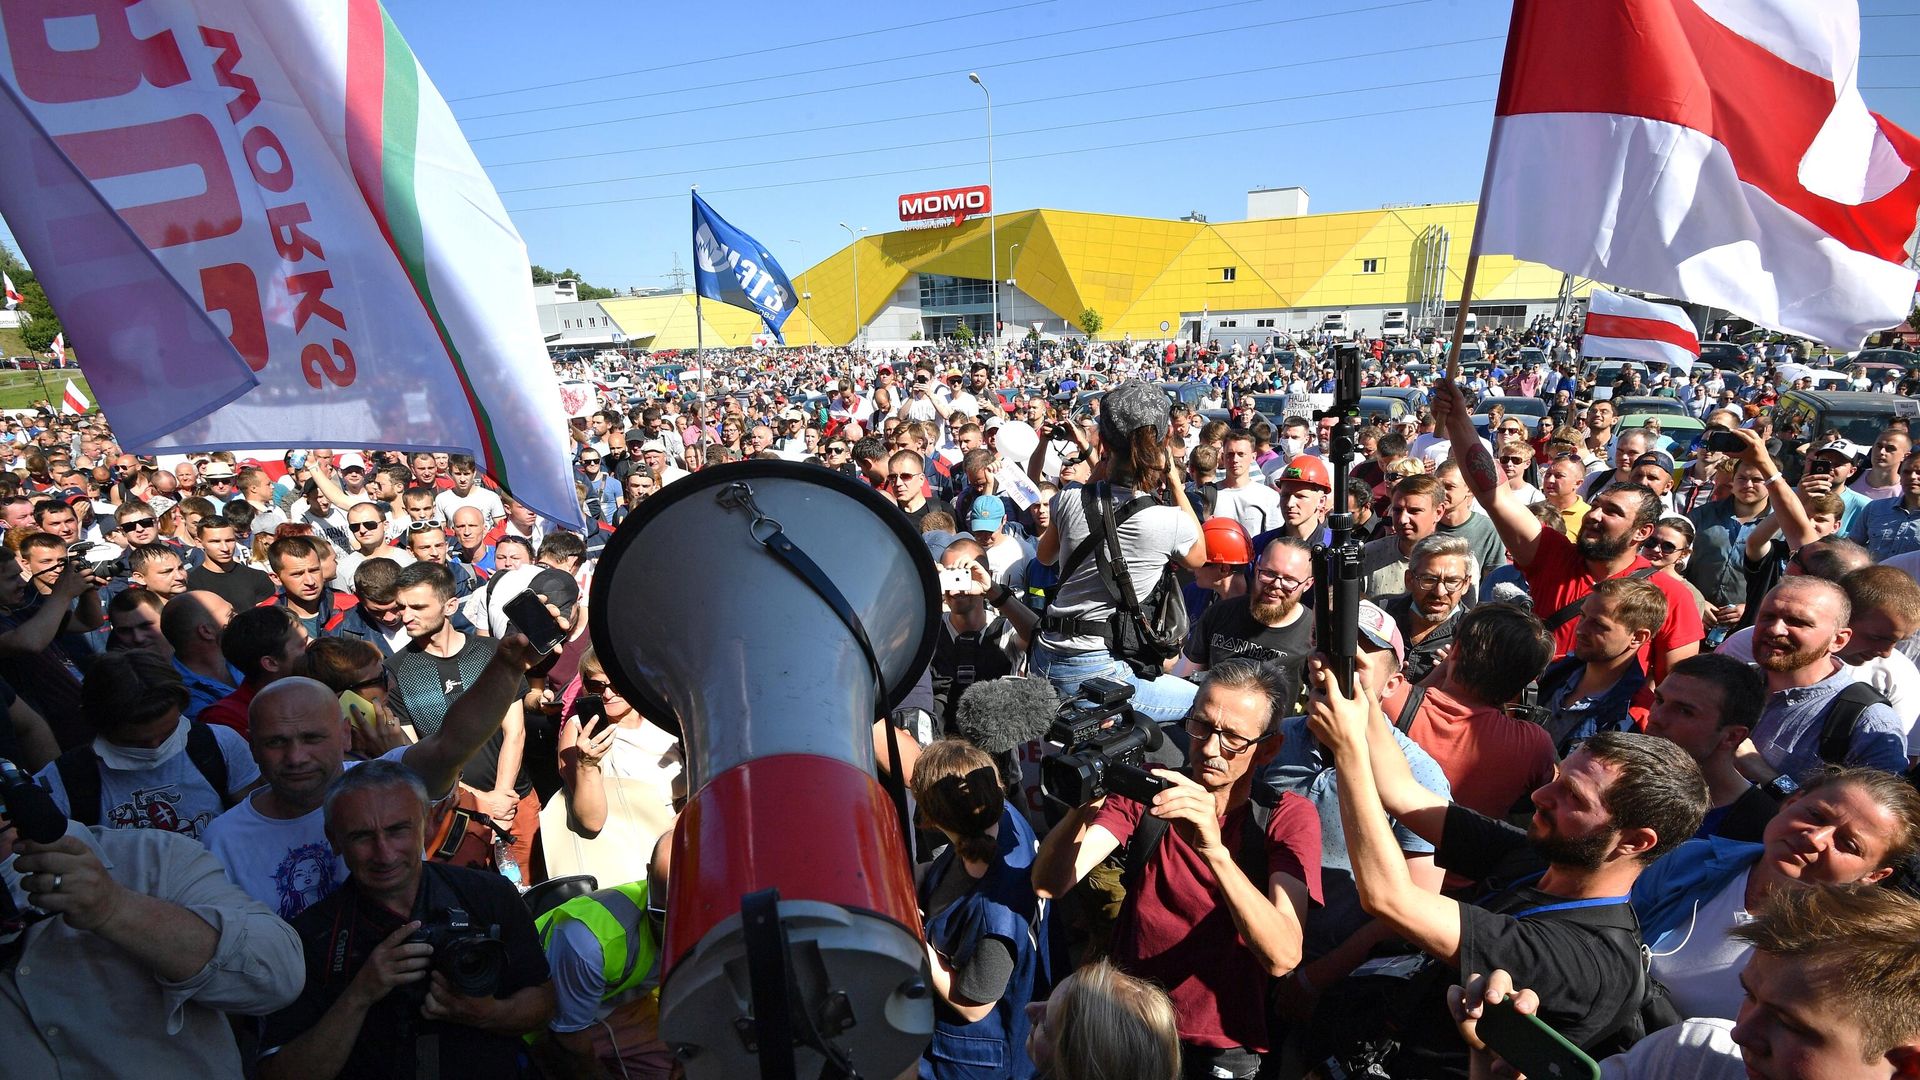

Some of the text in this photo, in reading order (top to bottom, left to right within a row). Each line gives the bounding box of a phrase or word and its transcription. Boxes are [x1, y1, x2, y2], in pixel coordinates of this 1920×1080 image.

[901, 191, 985, 216] MOMO
[1288, 394, 1310, 403] НАШИ
[1211, 633, 1248, 654] IRON
[1145, 776, 1159, 785] SONY
[333, 929, 349, 972] Canon
